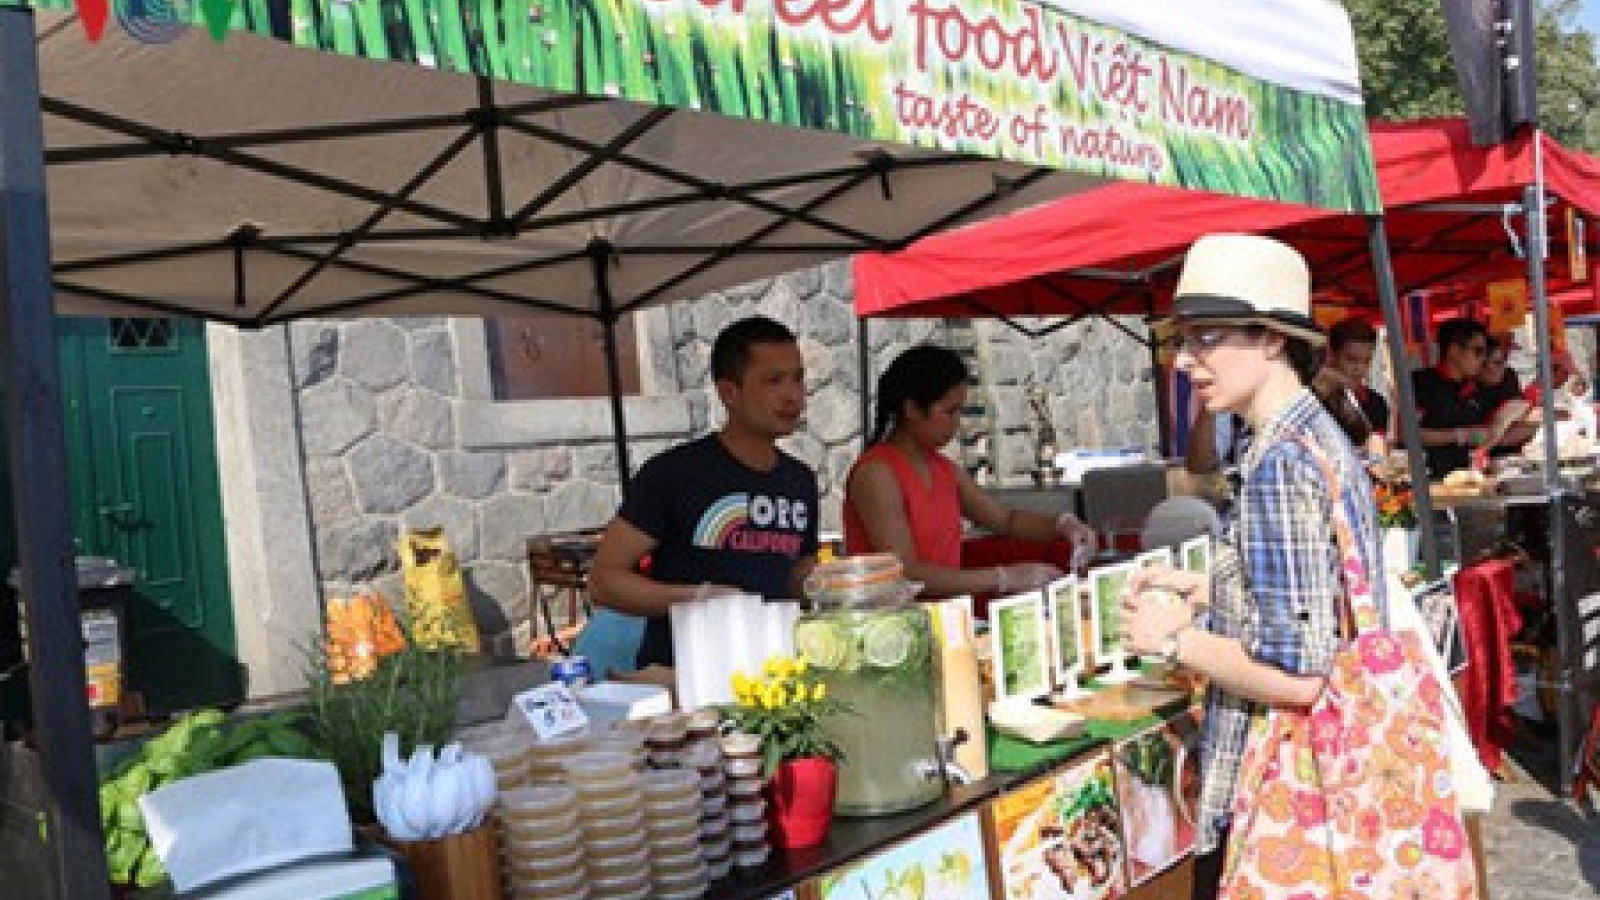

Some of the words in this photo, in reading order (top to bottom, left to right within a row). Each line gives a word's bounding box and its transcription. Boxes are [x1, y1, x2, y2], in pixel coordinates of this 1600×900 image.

[895, 80, 999, 142] taste
[1009, 104, 1049, 159] of
[908, 0, 1057, 81] food
[1159, 54, 1252, 140] Nam
